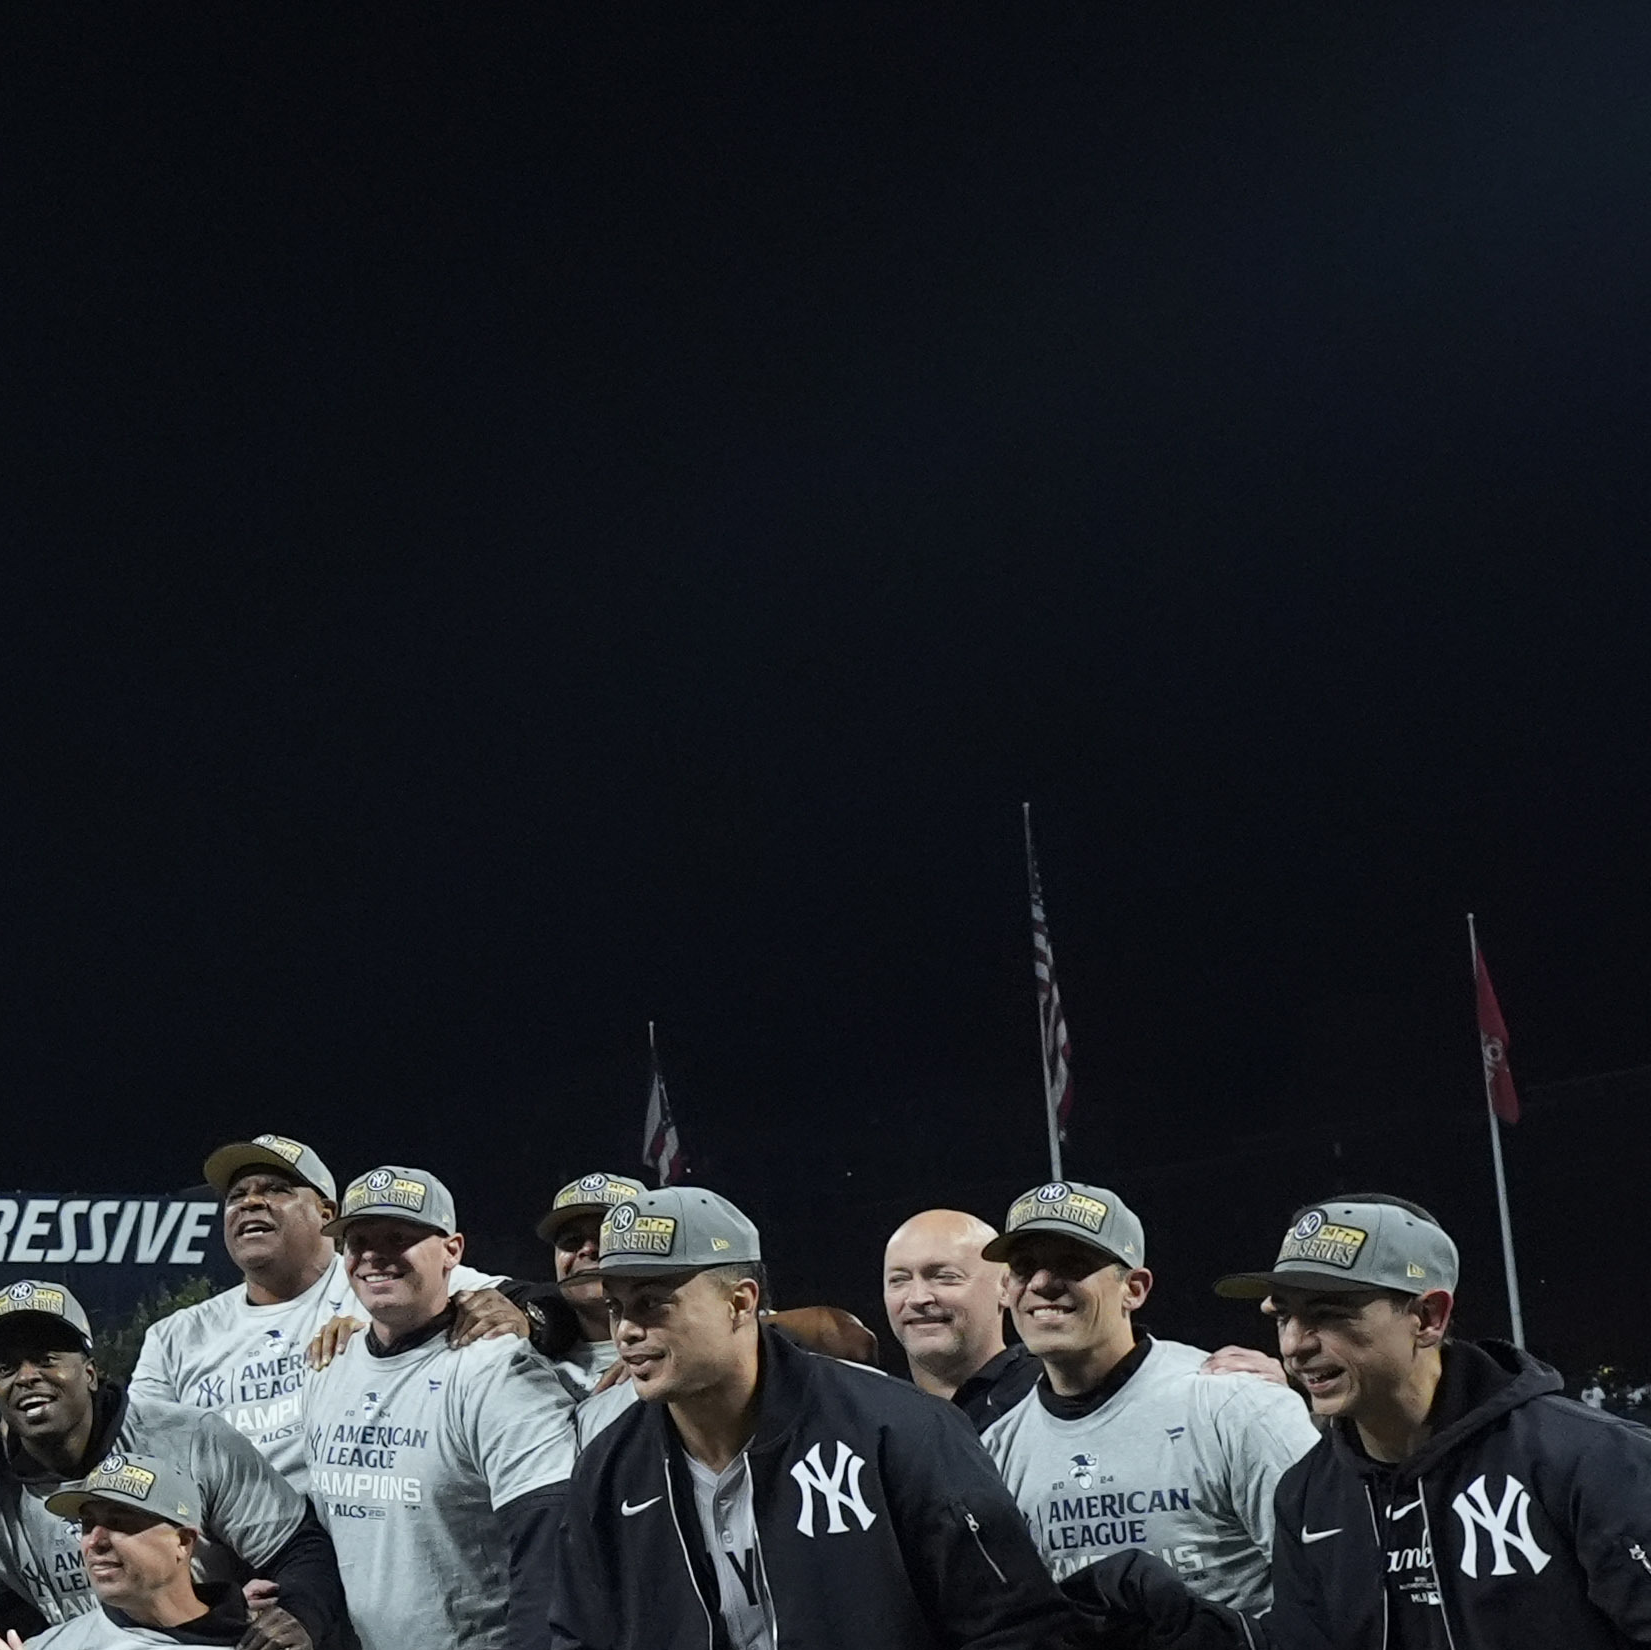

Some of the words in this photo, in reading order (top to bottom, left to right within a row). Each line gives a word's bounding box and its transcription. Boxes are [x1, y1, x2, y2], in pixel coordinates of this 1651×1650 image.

[638, 1220, 649, 1228] 24
[1050, 1203, 1100, 1232] SERIES
[622, 1233, 670, 1251] SERIES
[1300, 1240, 1354, 1265] SERIES
[332, 1426, 429, 1450] AMERICAN
[325, 1447, 397, 1469] LEAGUE
[333, 1504, 366, 1520] ALCS
[1048, 1486, 1191, 1525] AMERICAN
[1048, 1519, 1147, 1550] LEAGUE
